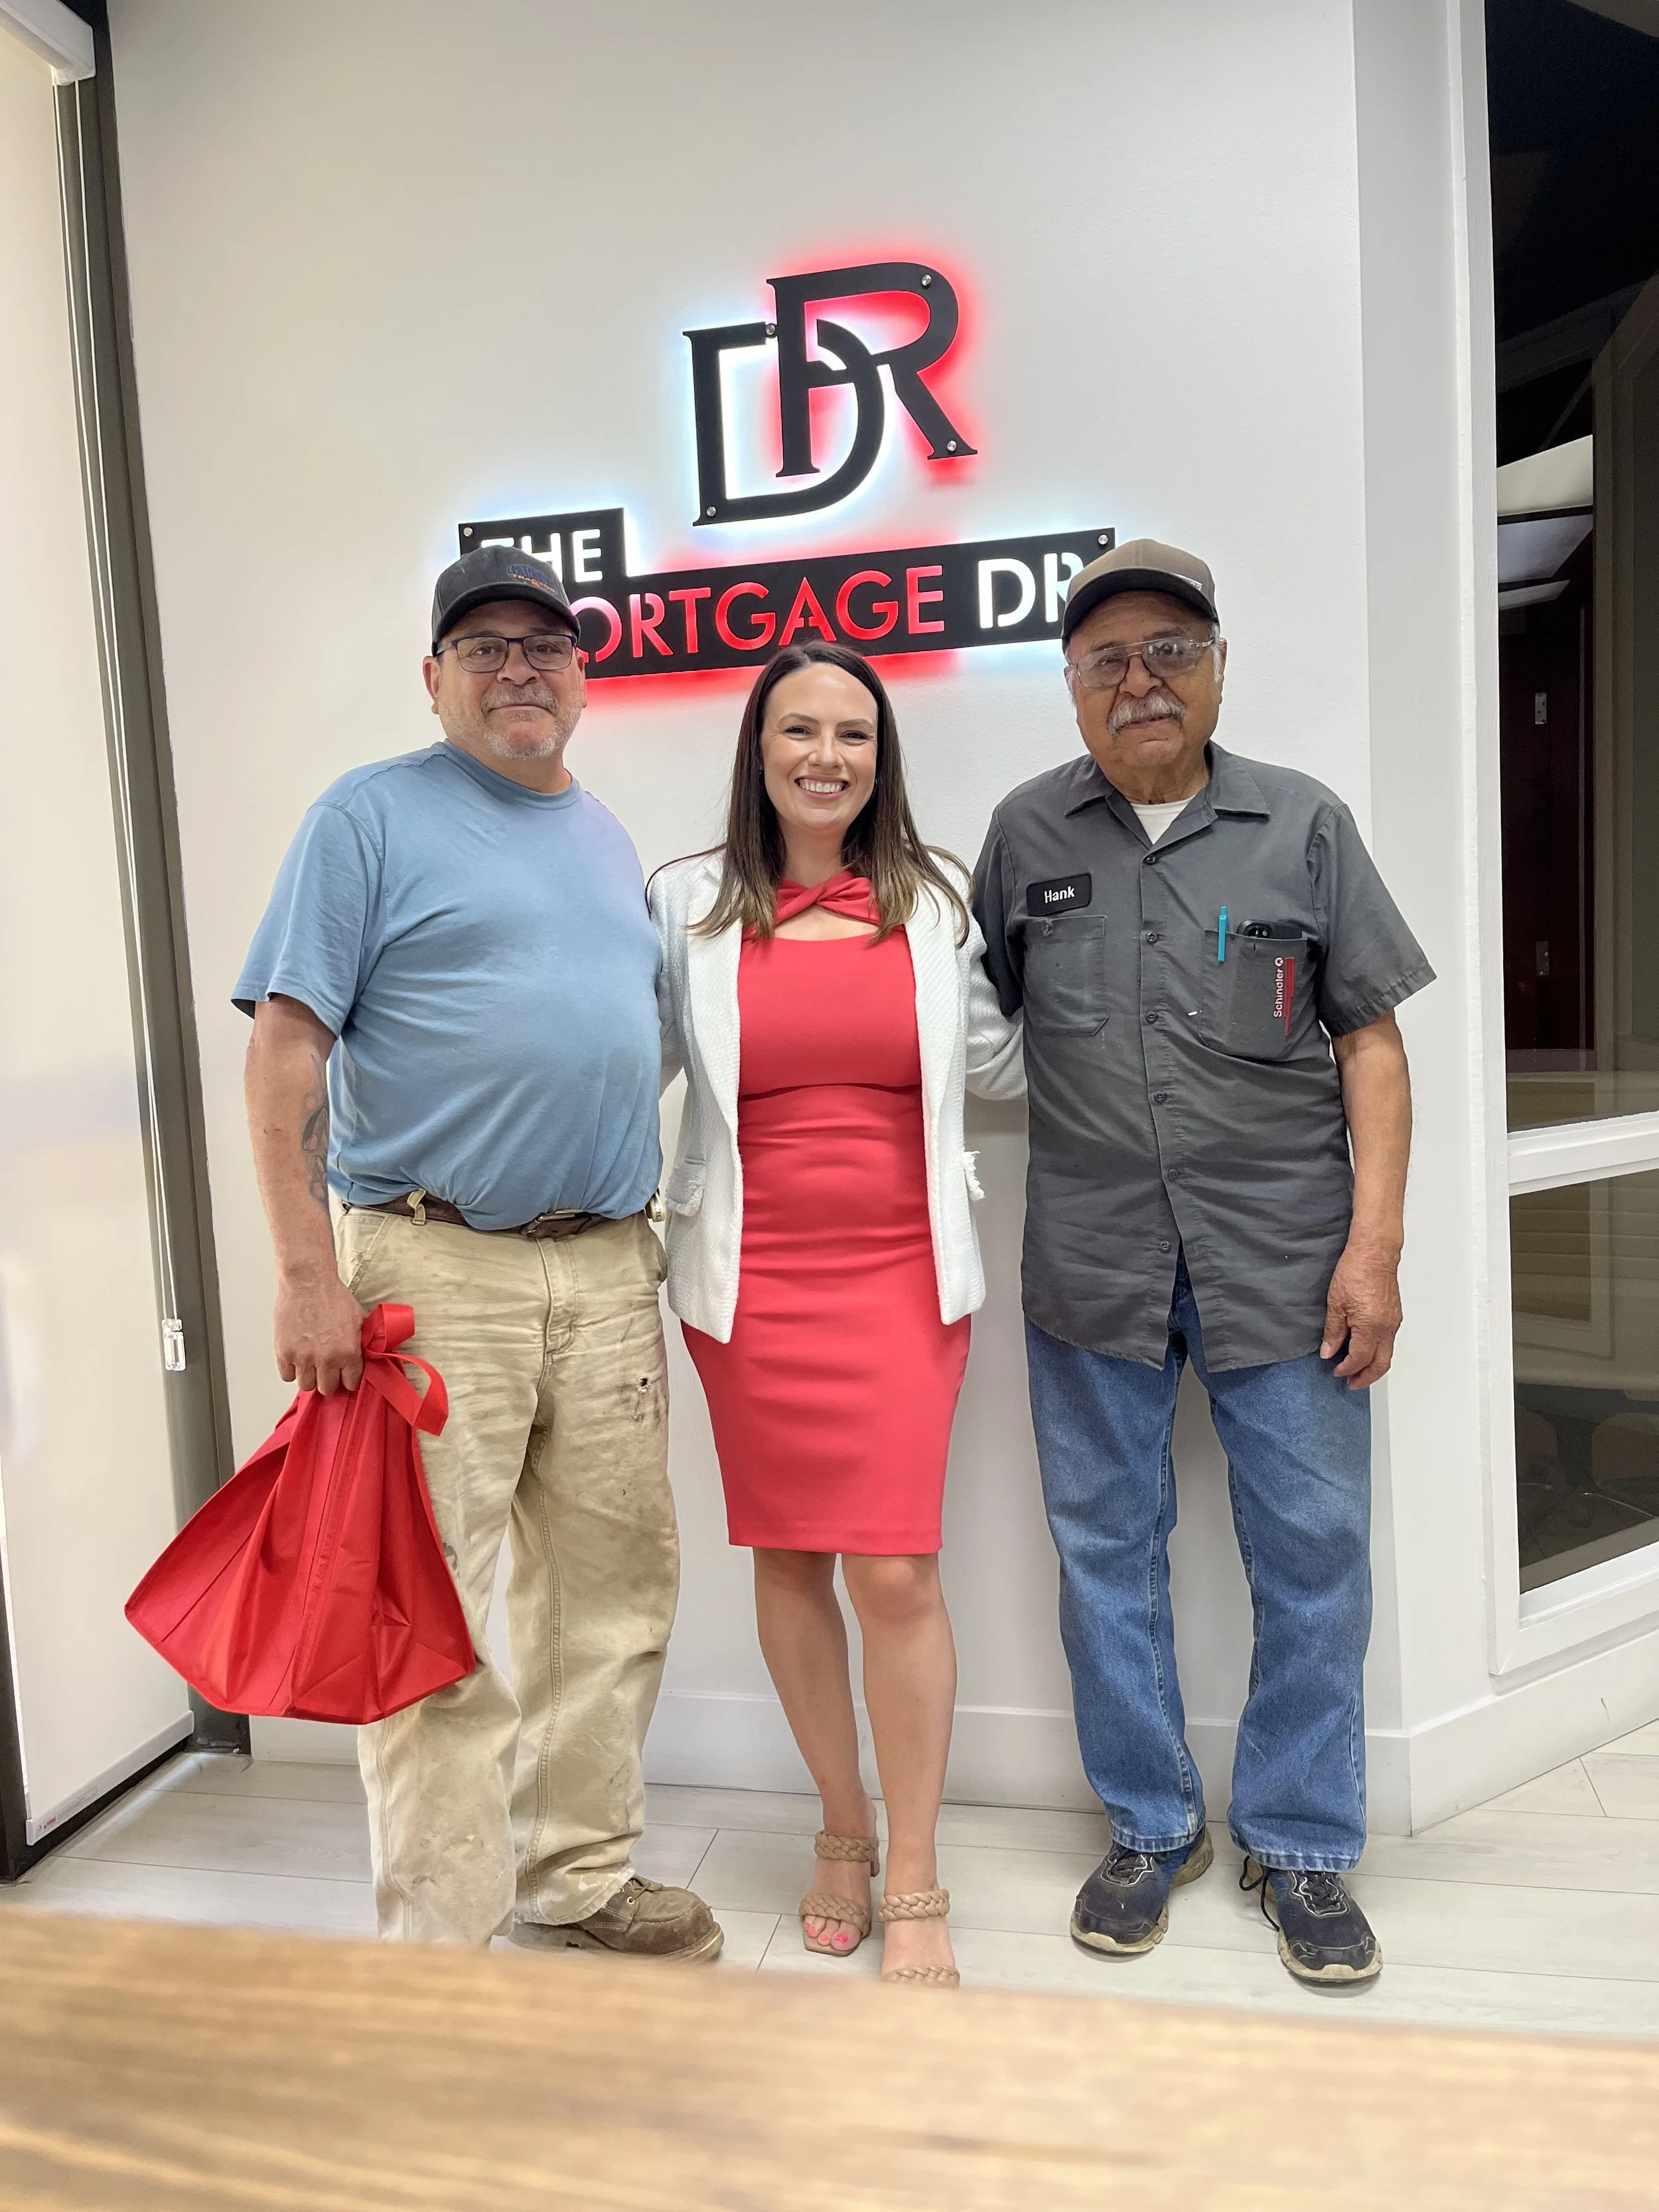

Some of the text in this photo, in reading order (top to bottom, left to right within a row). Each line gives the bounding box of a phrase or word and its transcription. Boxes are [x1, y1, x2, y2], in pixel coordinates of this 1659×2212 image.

[570, 552, 1084, 662] ORTGAGE DR
[1044, 885, 1075, 903] Hank
[1273, 968, 1283, 1017] Schindler
